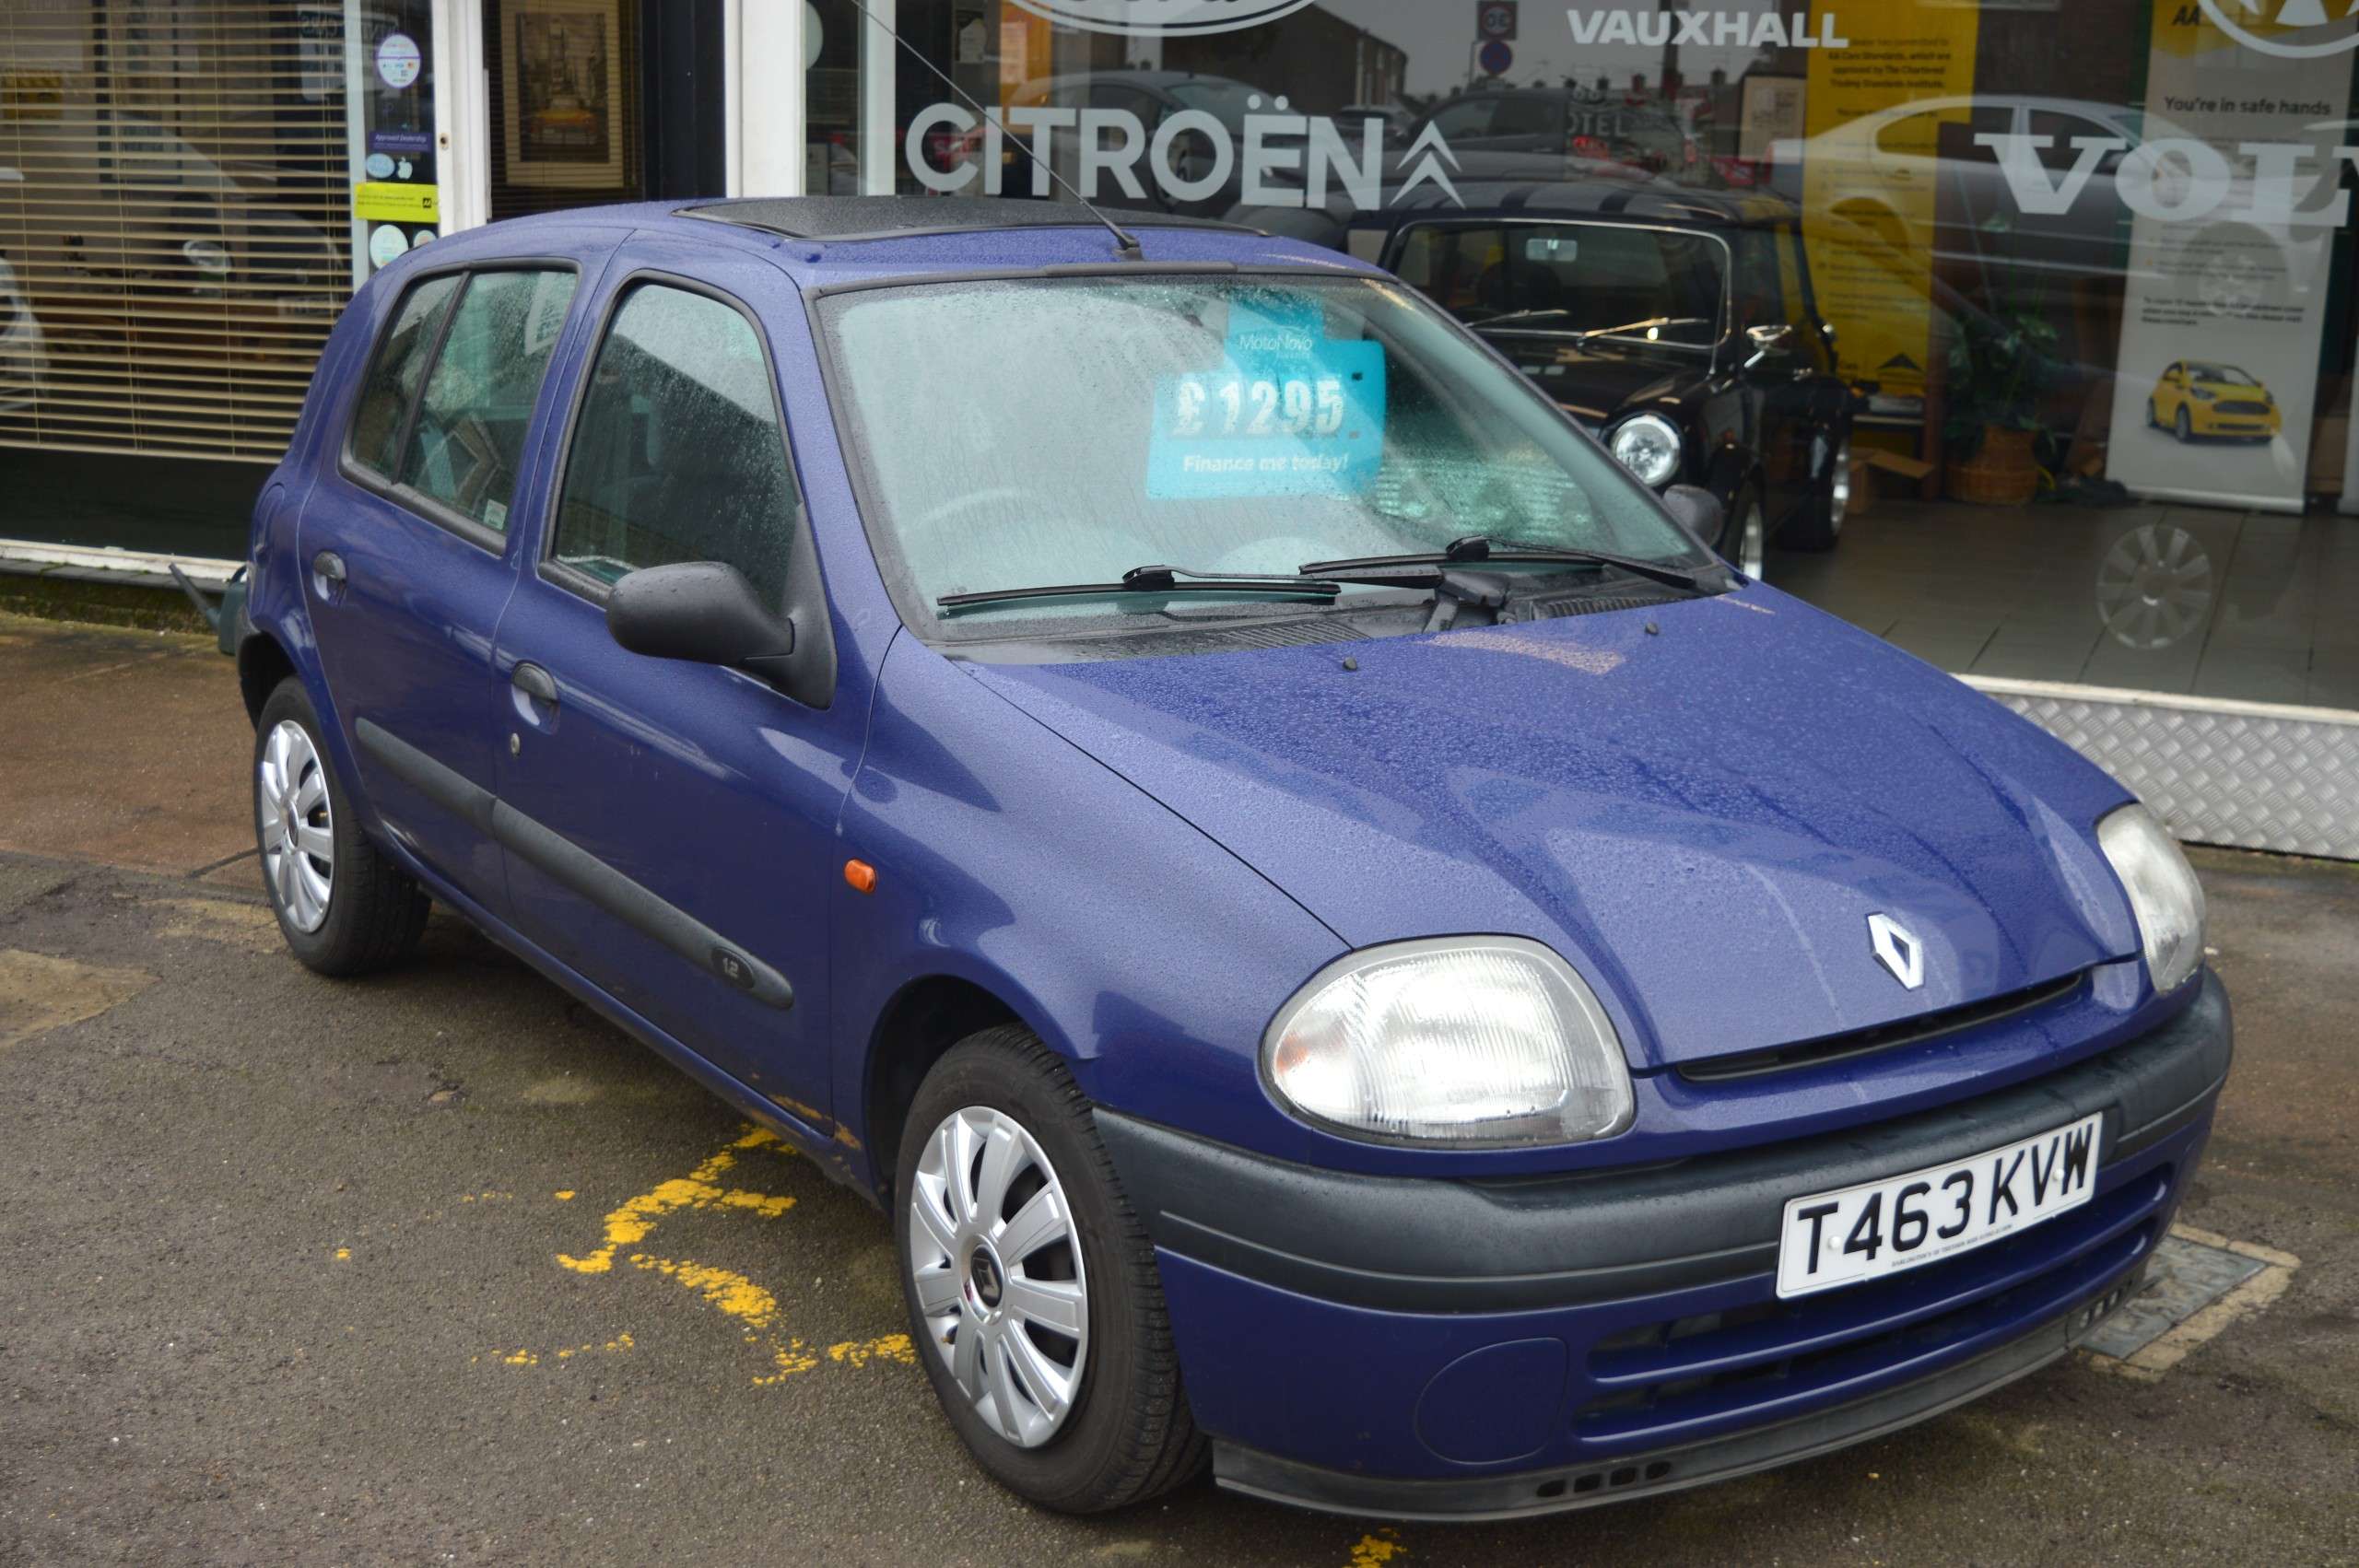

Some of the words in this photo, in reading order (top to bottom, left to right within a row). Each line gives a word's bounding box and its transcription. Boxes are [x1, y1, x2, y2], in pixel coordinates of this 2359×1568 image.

[1567, 9, 1849, 48] VAUXHALL
[2172, 6, 2201, 26] AA
[2165, 97, 2217, 112] You're
[2219, 98, 2236, 112] in
[2240, 98, 2277, 113] safe
[2279, 99, 2331, 115] hands
[905, 95, 1382, 210] CITROËN
[1183, 455, 1254, 472] Finance
[1260, 458, 1289, 471] me
[1293, 453, 1349, 472] today!
[1797, 1168, 1974, 1275] T463
[1989, 1122, 2094, 1225] KVW
